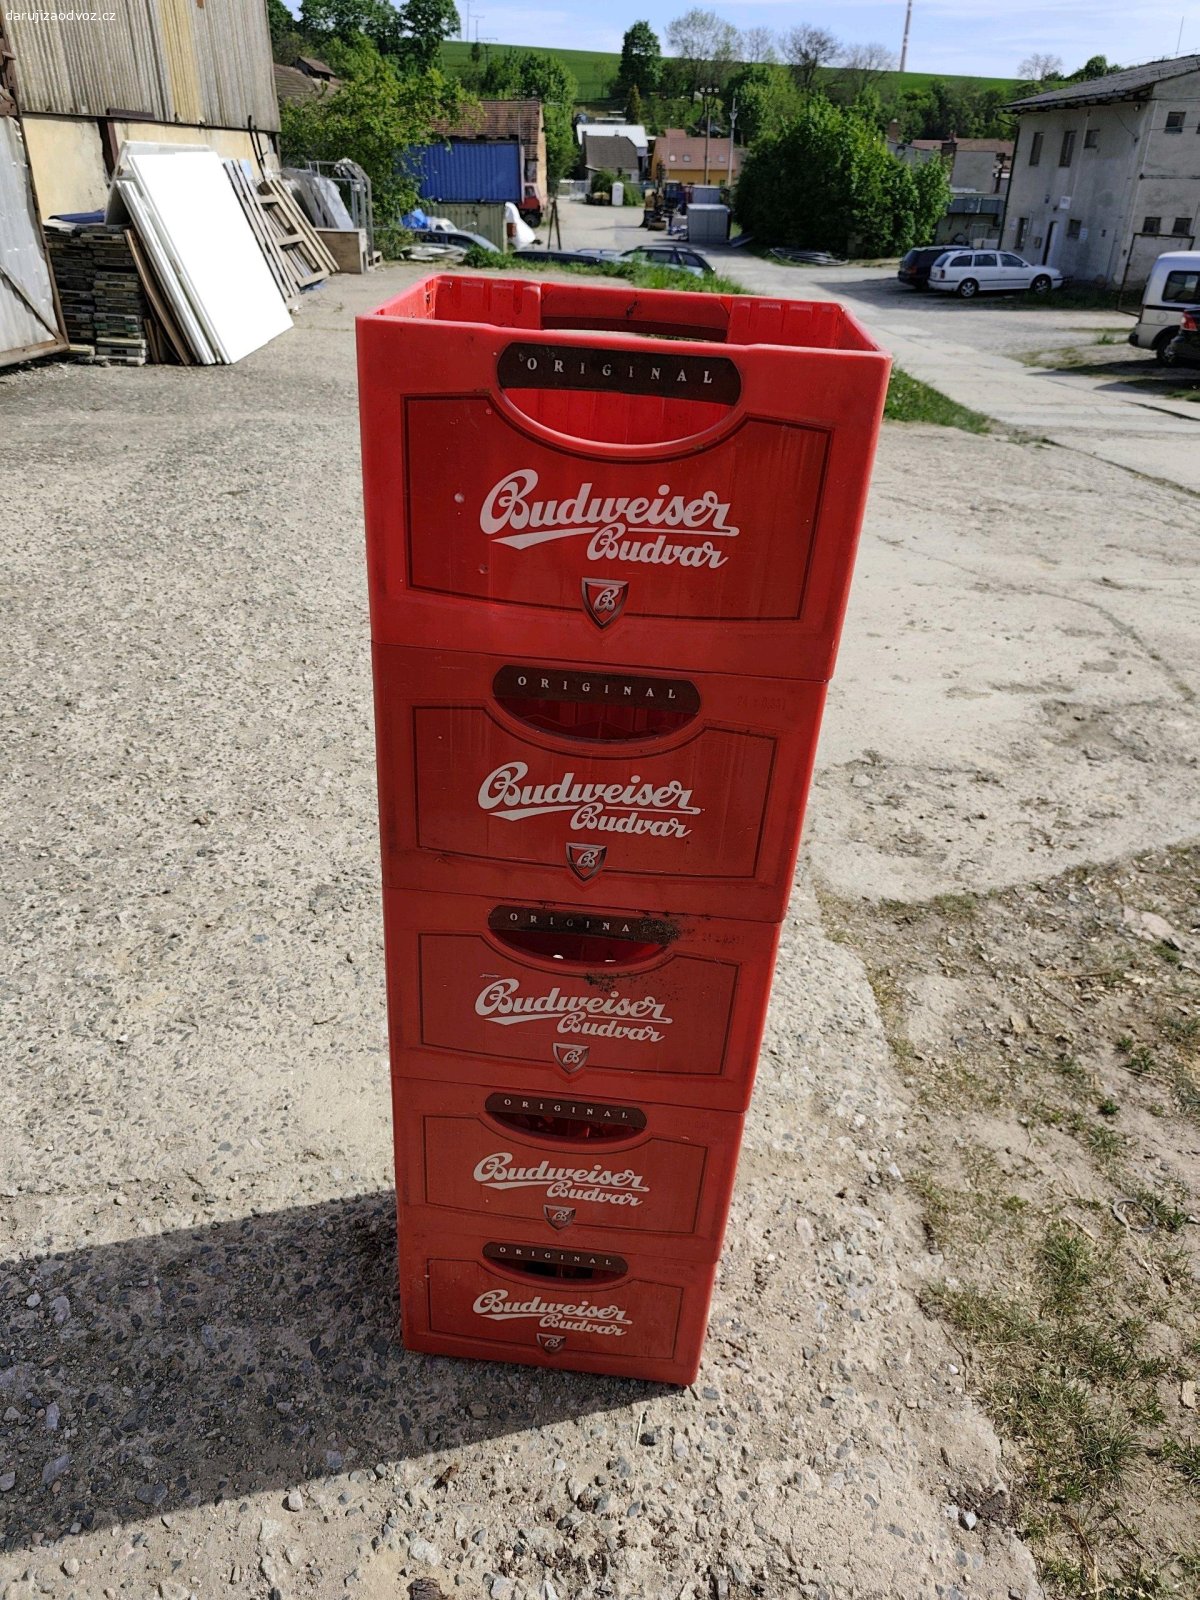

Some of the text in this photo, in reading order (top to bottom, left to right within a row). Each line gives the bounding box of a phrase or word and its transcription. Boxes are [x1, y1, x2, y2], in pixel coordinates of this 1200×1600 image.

[526, 357, 714, 385] ORIGINAL
[480, 469, 739, 541] Budweiser
[587, 522, 729, 570] Budvar
[517, 676, 677, 700] ORIGINAL
[478, 761, 700, 815] Budweiser
[570, 803, 693, 838] Budvar
[475, 978, 673, 1024] Budweiser
[557, 1012, 666, 1042] Budvar
[503, 1098, 629, 1119] ORIGINAL
[473, 1152, 650, 1192] Budweiser
[546, 1179, 643, 1207] Budvar
[499, 1246, 612, 1266] ORIGINAL
[472, 1289, 633, 1324] Budweiser
[539, 1313, 627, 1337] Budvar
